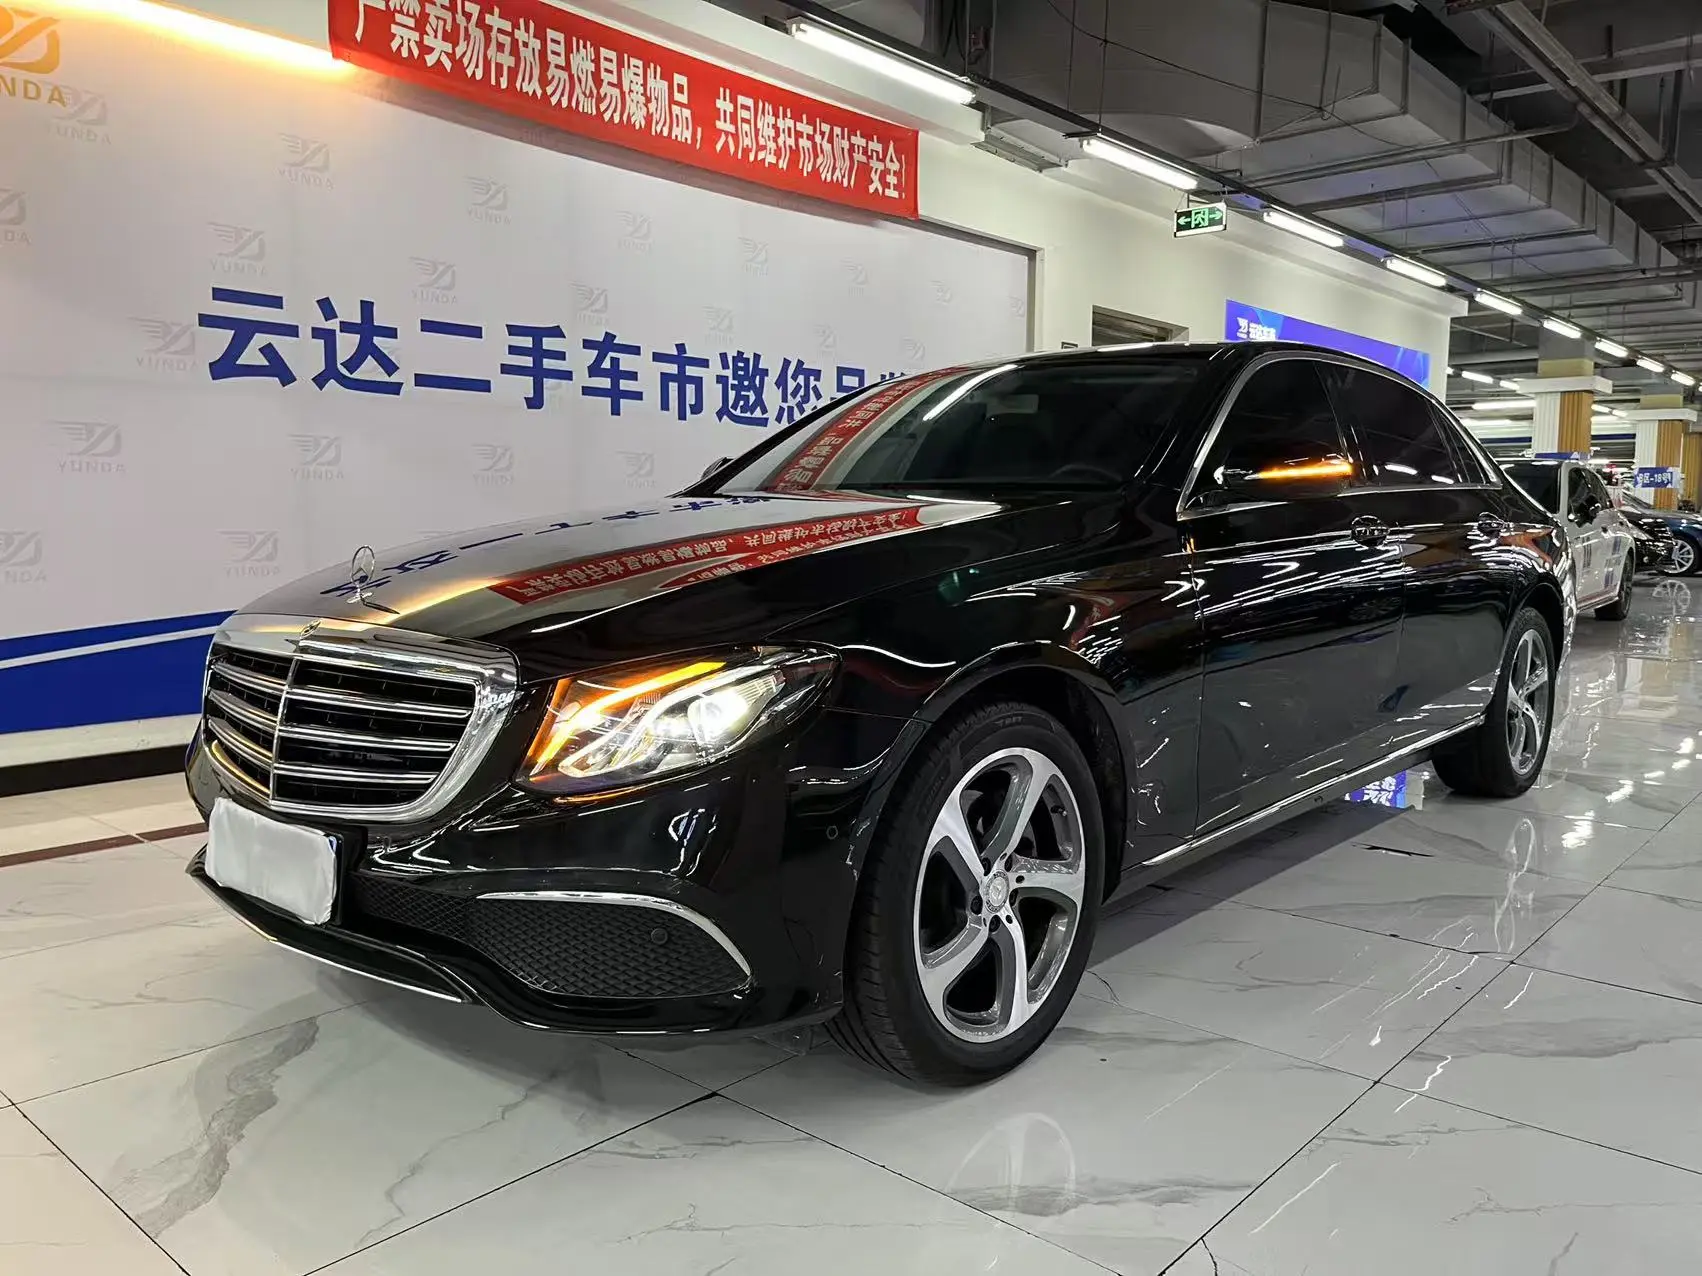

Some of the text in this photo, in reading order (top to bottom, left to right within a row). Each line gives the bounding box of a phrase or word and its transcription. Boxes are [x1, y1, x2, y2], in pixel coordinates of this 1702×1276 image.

[197, 286, 906, 428] 云达二手车市邀您
